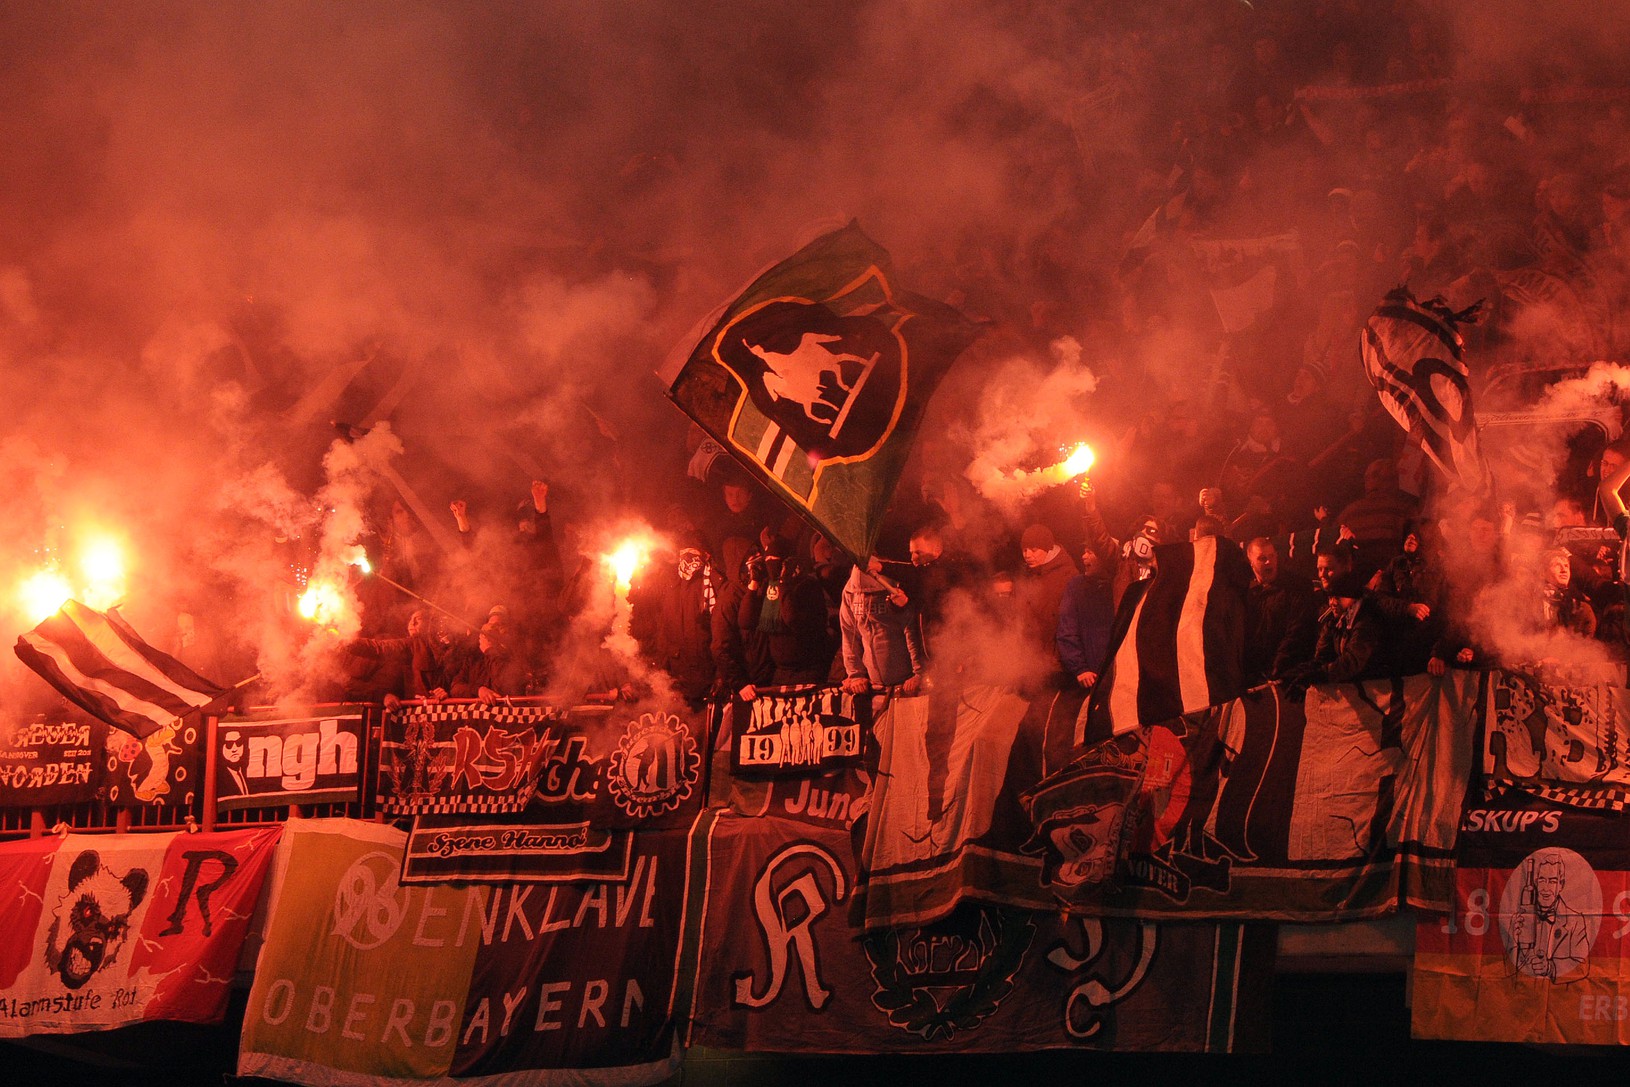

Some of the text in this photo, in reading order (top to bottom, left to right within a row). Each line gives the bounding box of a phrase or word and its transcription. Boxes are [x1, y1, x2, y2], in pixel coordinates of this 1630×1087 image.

[247, 720, 357, 790] ngh
[1461, 809, 1563, 833] SKUP'S
[427, 833, 496, 858] Szene
[111, 986, 137, 1009] Rot
